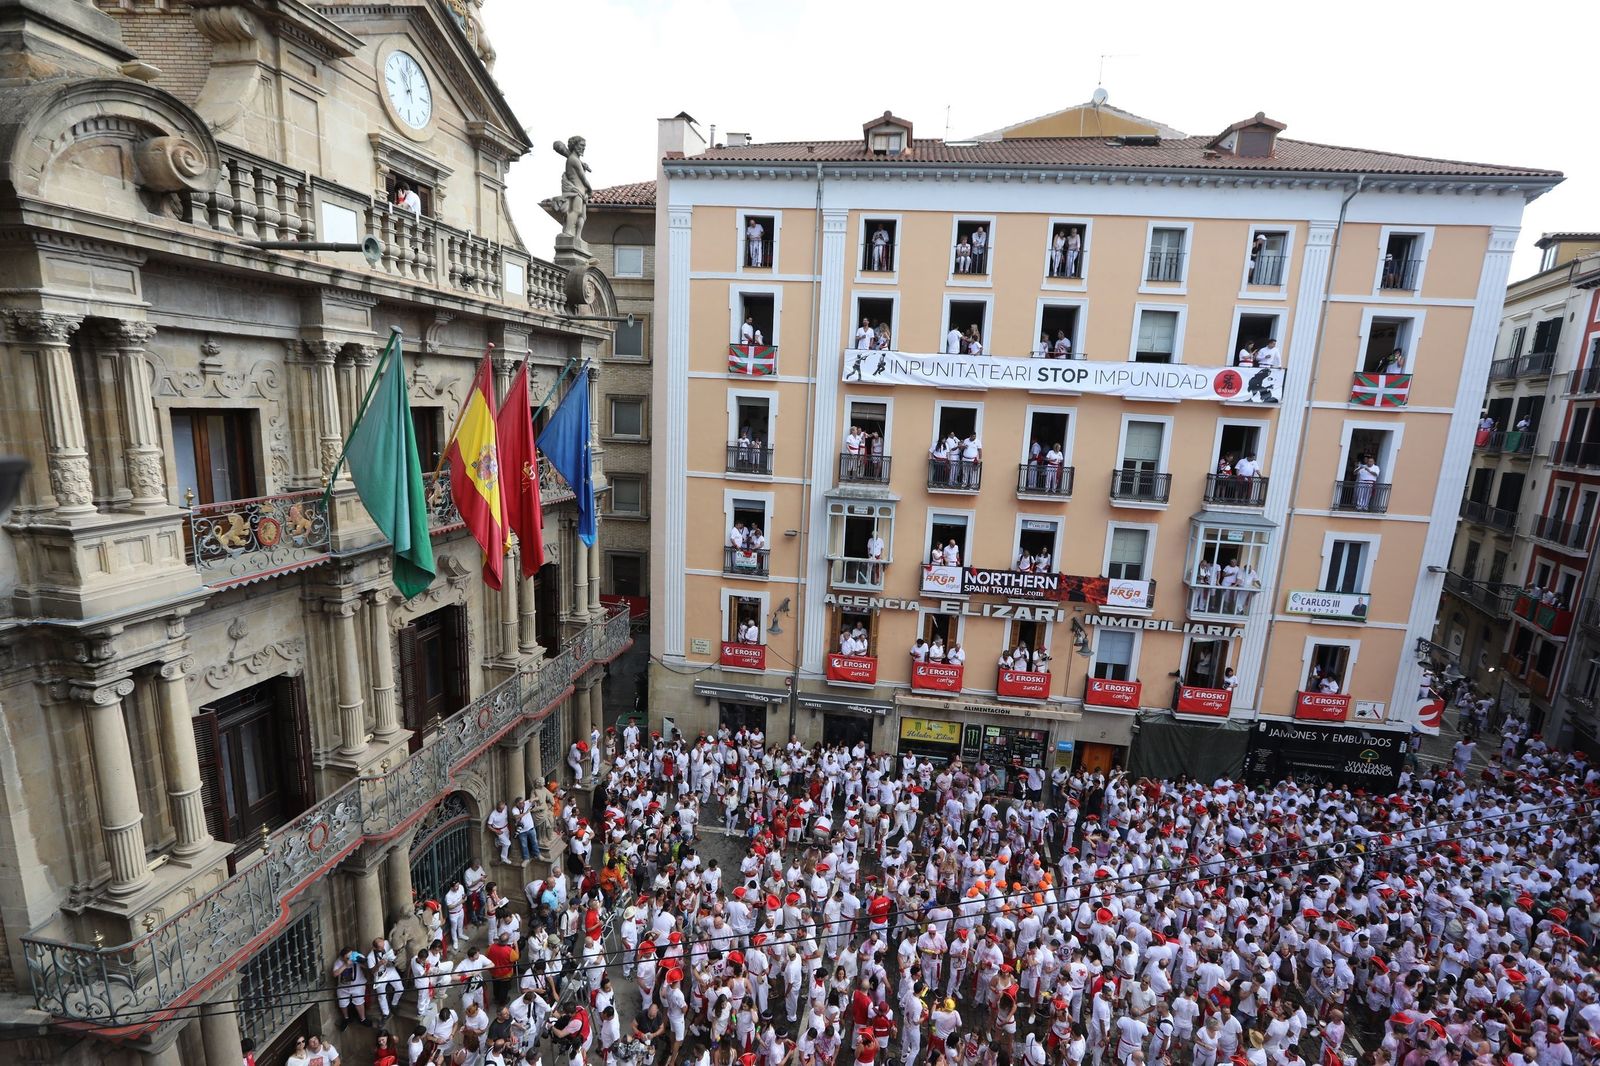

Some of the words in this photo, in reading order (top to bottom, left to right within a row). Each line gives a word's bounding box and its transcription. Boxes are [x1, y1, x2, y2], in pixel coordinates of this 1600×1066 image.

[890, 359, 1031, 381] INPUNITATEARI
[1037, 367, 1088, 383] STOP
[1094, 370, 1208, 390] IMPUNIDAD
[926, 575, 955, 586] ARGA
[964, 570, 1058, 589] NORTHERN
[964, 585, 989, 593] SPAIN
[1109, 588, 1140, 599] ARGA
[1301, 597, 1331, 607] CARLOS
[1332, 599, 1341, 608] III
[823, 593, 920, 611] AGENCIA
[940, 601, 1065, 622] ELIZARI
[1085, 615, 1246, 637] INMOBILIARIA
[734, 649, 761, 657] EROSKI
[844, 660, 871, 669] EROSKI
[929, 668, 957, 676] EROSKI
[936, 677, 955, 686] contigo
[1015, 675, 1044, 683] EROSKI
[1105, 684, 1134, 692] EROSKI
[1112, 693, 1132, 702] contigo
[1195, 692, 1225, 700] EROSKI
[1203, 701, 1223, 710] contigo
[1323, 706, 1342, 715] contigo
[1268, 728, 1317, 741] JAMONES
[1321, 732, 1329, 741] Y
[1344, 766, 1393, 776] SALAMANCA
